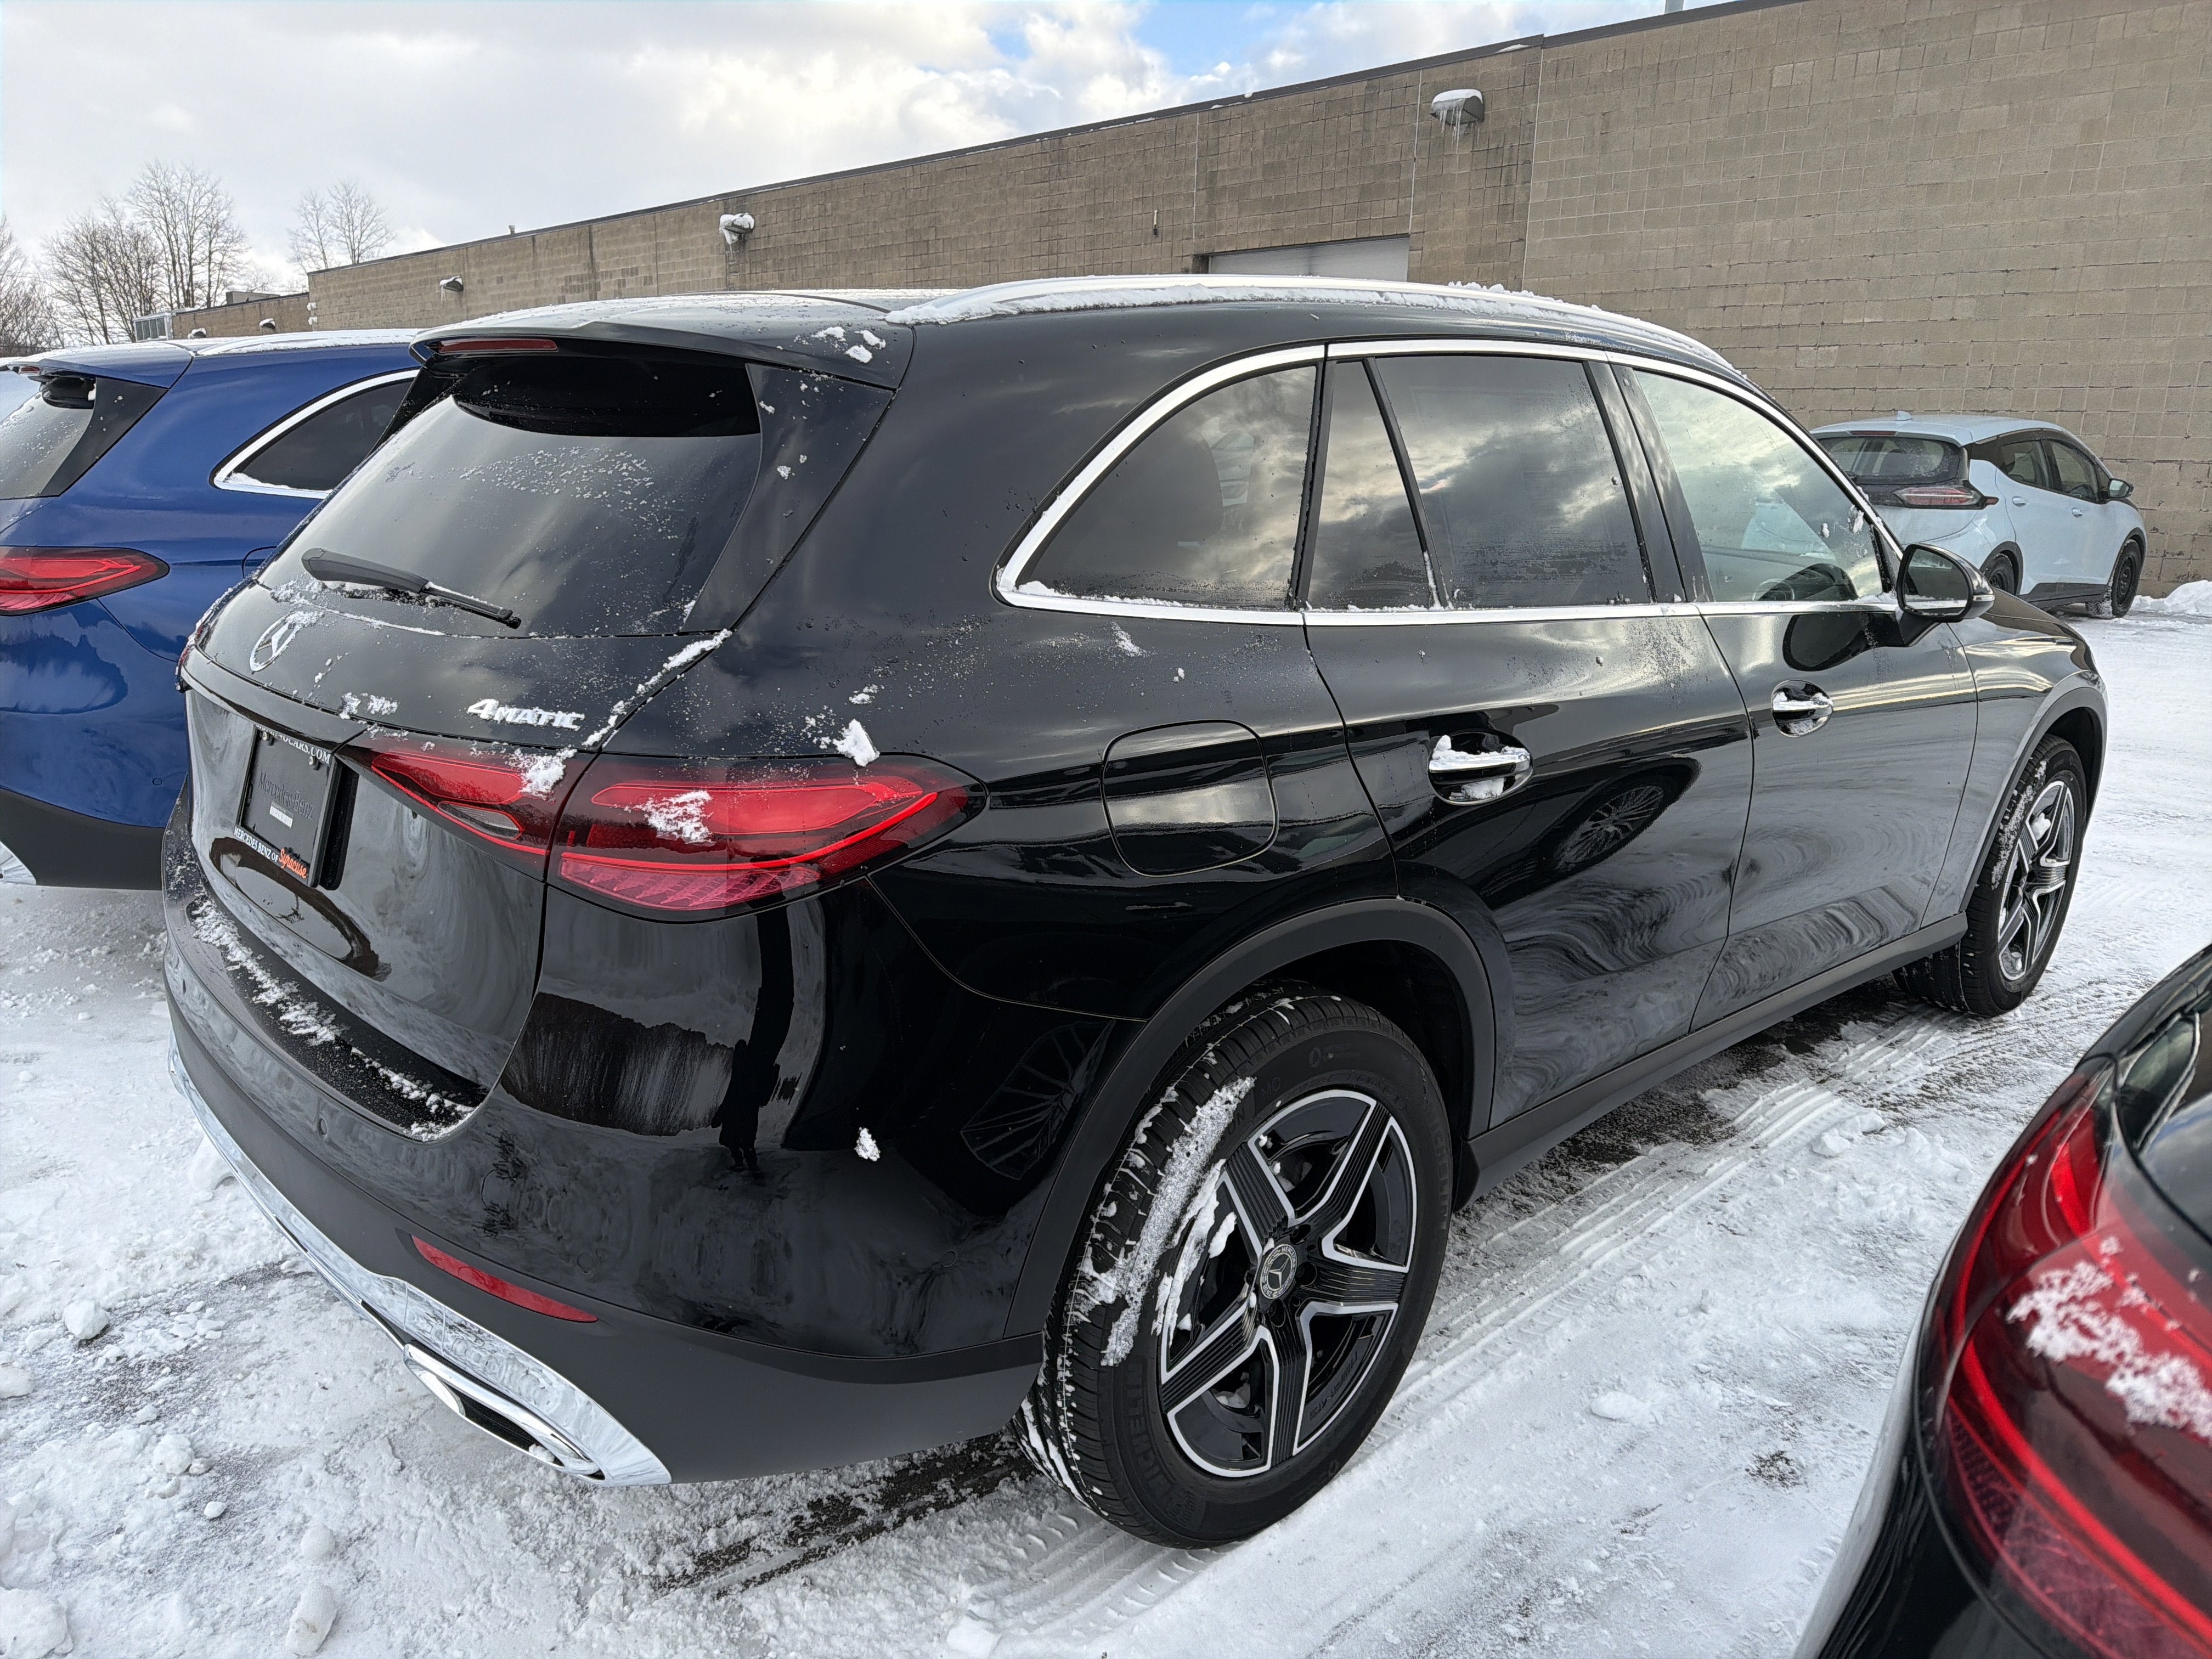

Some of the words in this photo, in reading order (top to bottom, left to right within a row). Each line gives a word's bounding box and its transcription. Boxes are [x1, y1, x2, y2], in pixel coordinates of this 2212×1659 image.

[467, 698, 585, 731] 4MATIC
[258, 770, 314, 820] Mercedes-Benz
[234, 826, 257, 850] MERCEDES
[257, 843, 272, 859] BENZ
[271, 852, 279, 862] OF
[278, 848, 307, 879] Syracuse
